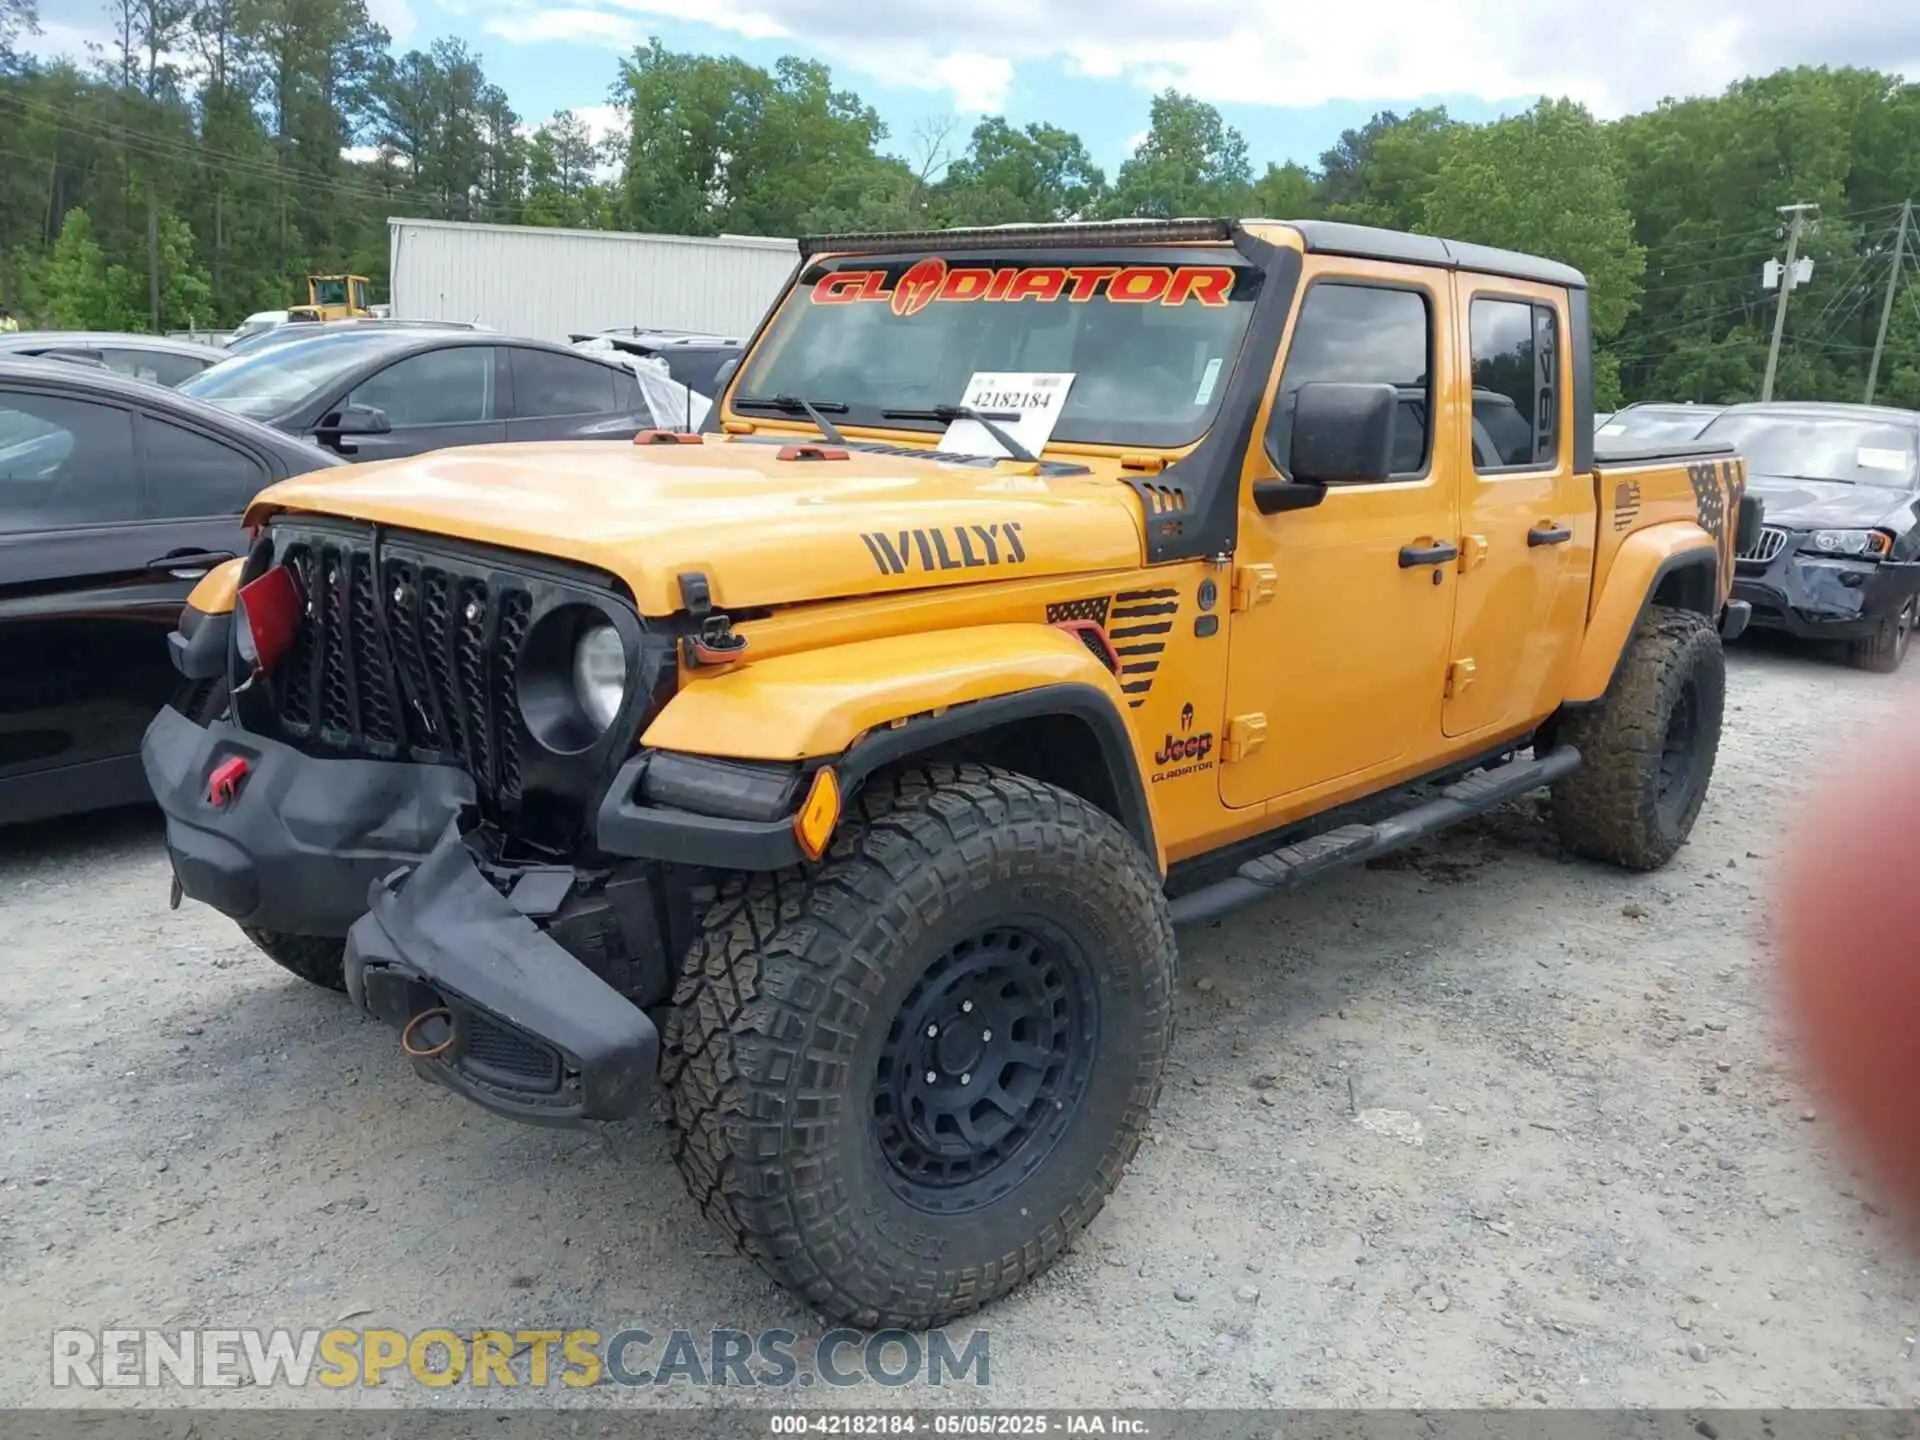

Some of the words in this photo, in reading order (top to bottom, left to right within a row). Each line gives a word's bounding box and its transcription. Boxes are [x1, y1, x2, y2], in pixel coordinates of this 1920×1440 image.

[971, 391, 1052, 409] 42182184
[859, 522, 1026, 575] WILLYS
[1155, 732, 1213, 766] Jeep
[1151, 761, 1213, 784] GLADIATOR
